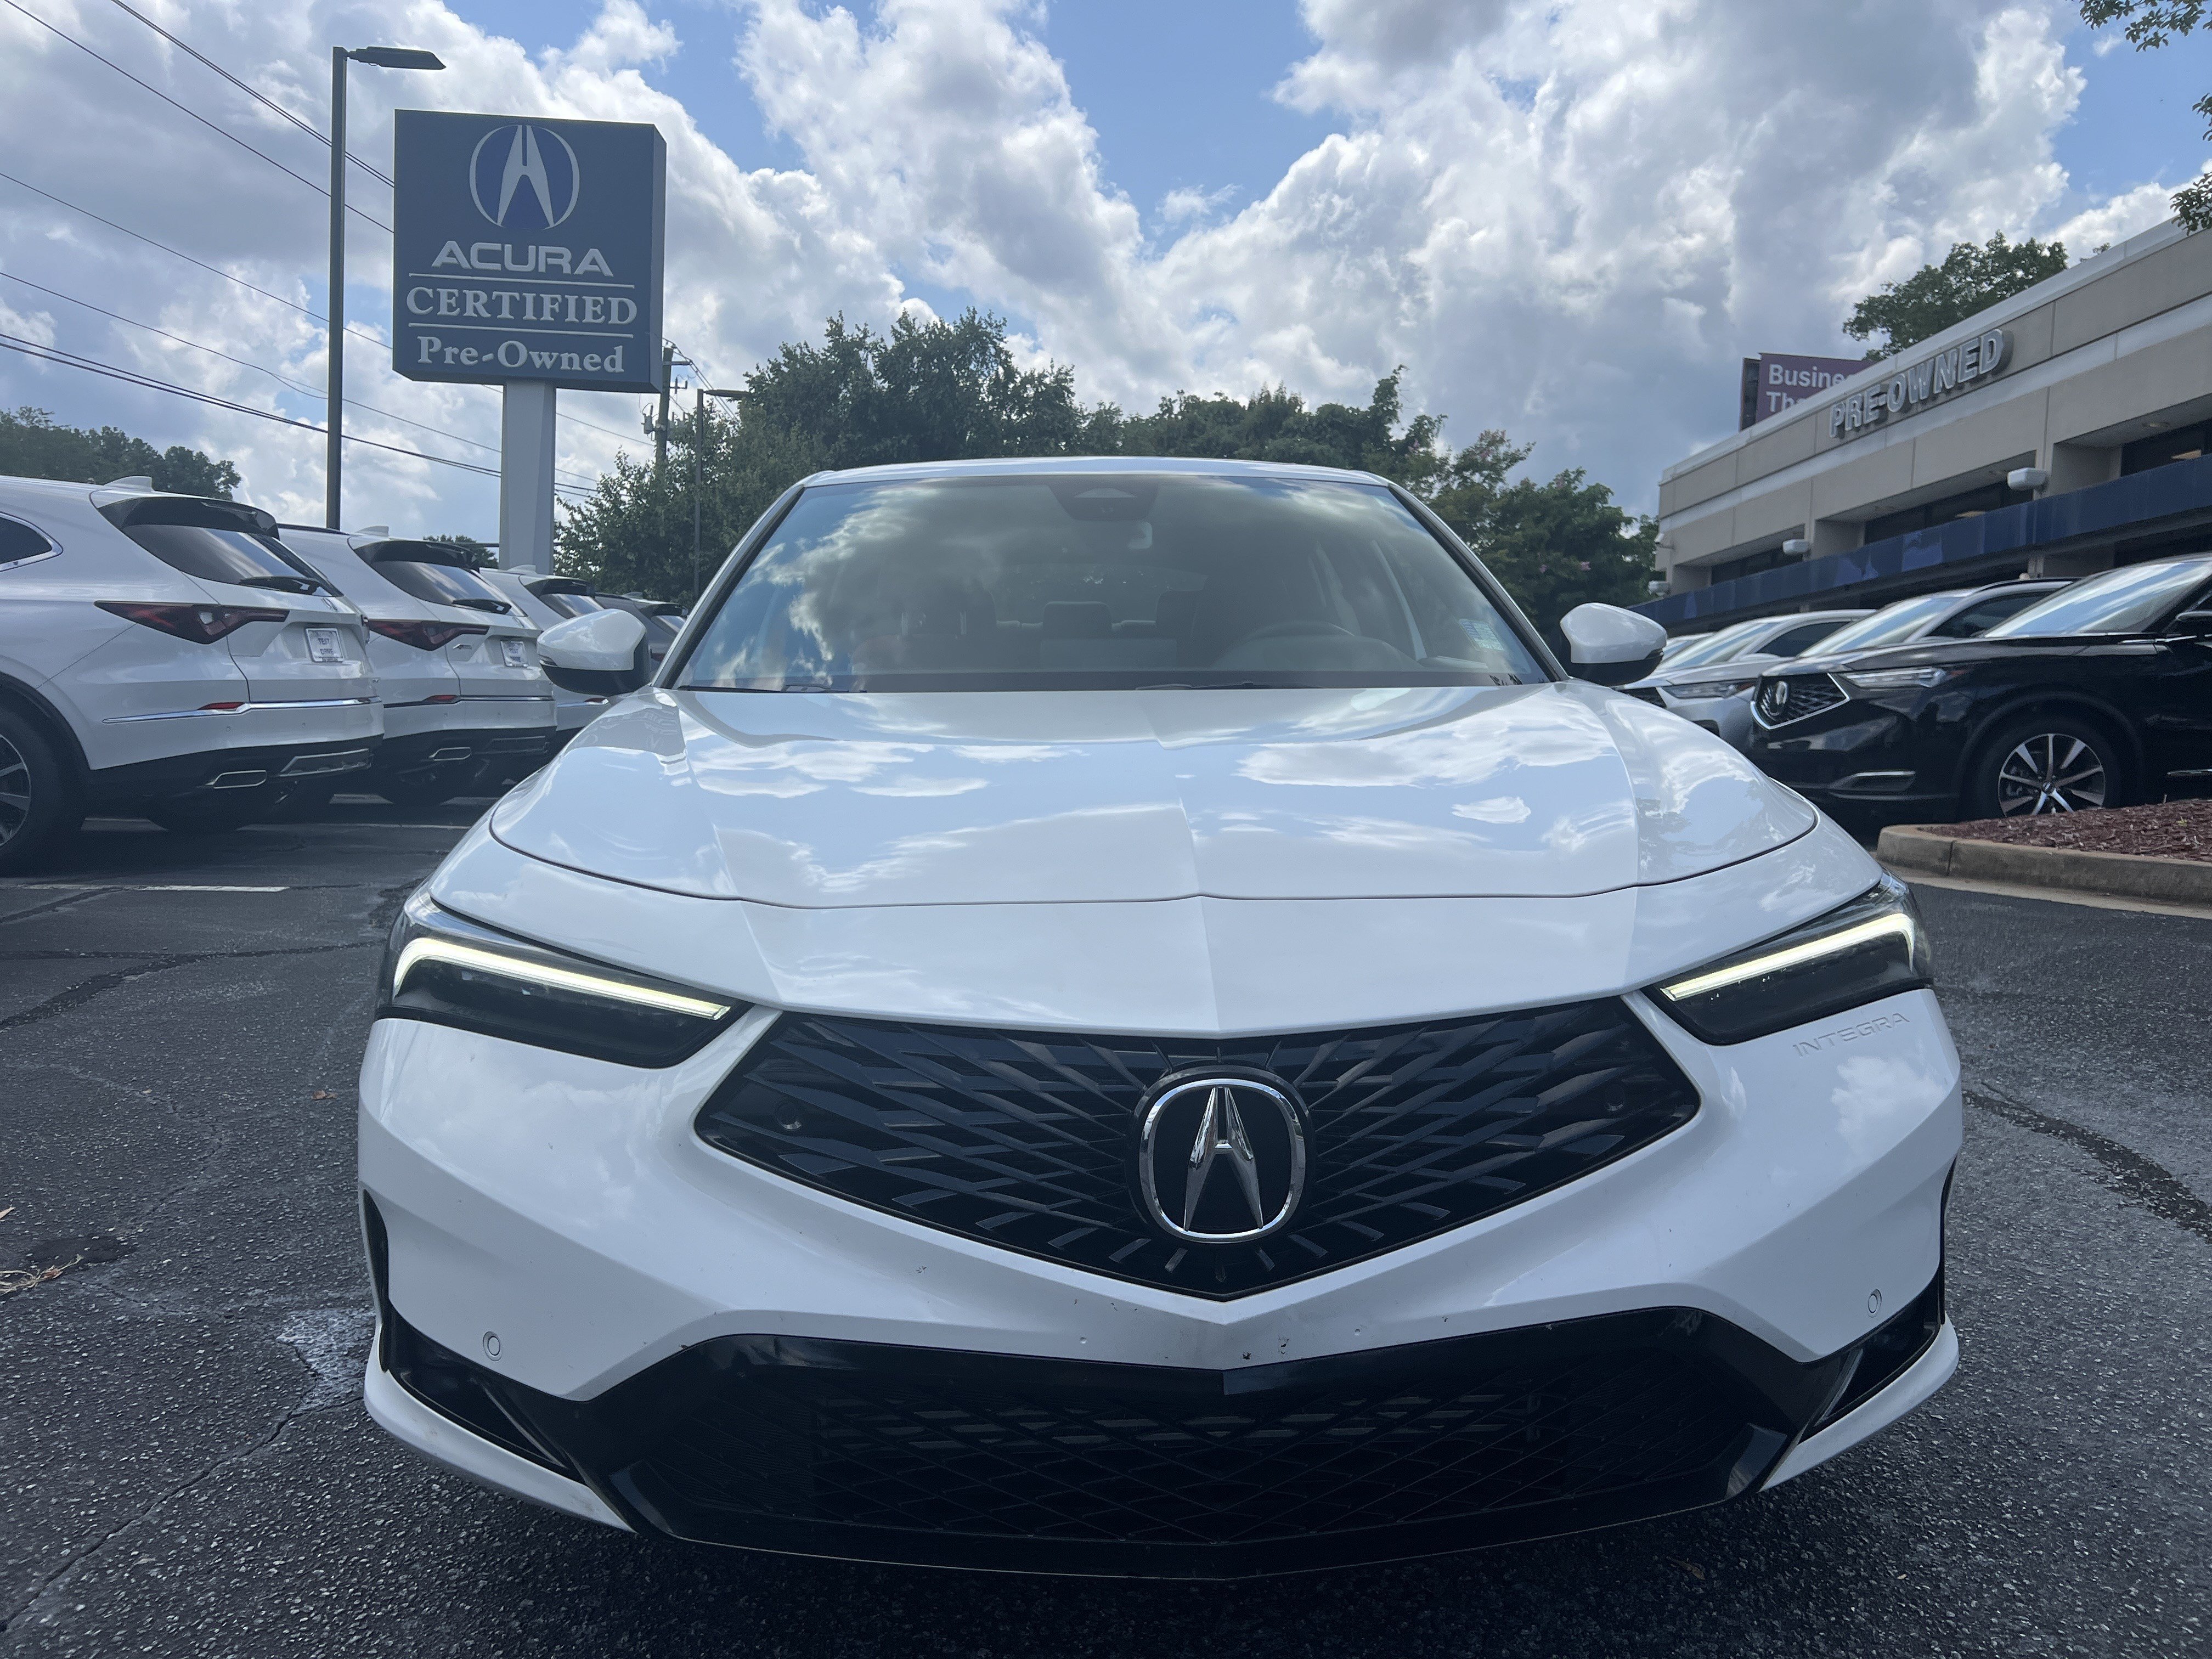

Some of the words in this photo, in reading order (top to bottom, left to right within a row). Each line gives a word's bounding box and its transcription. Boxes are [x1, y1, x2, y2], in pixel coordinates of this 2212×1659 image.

[431, 240, 614, 276] ACURA
[406, 286, 637, 325] CERTIFIED
[417, 336, 625, 373] Pre-Owned
[1768, 364, 1857, 388] Busine
[1829, 329, 2006, 438] PRE-OWNED
[1765, 391, 1808, 412] Th
[1792, 1013, 1910, 1057] INTEGRA
